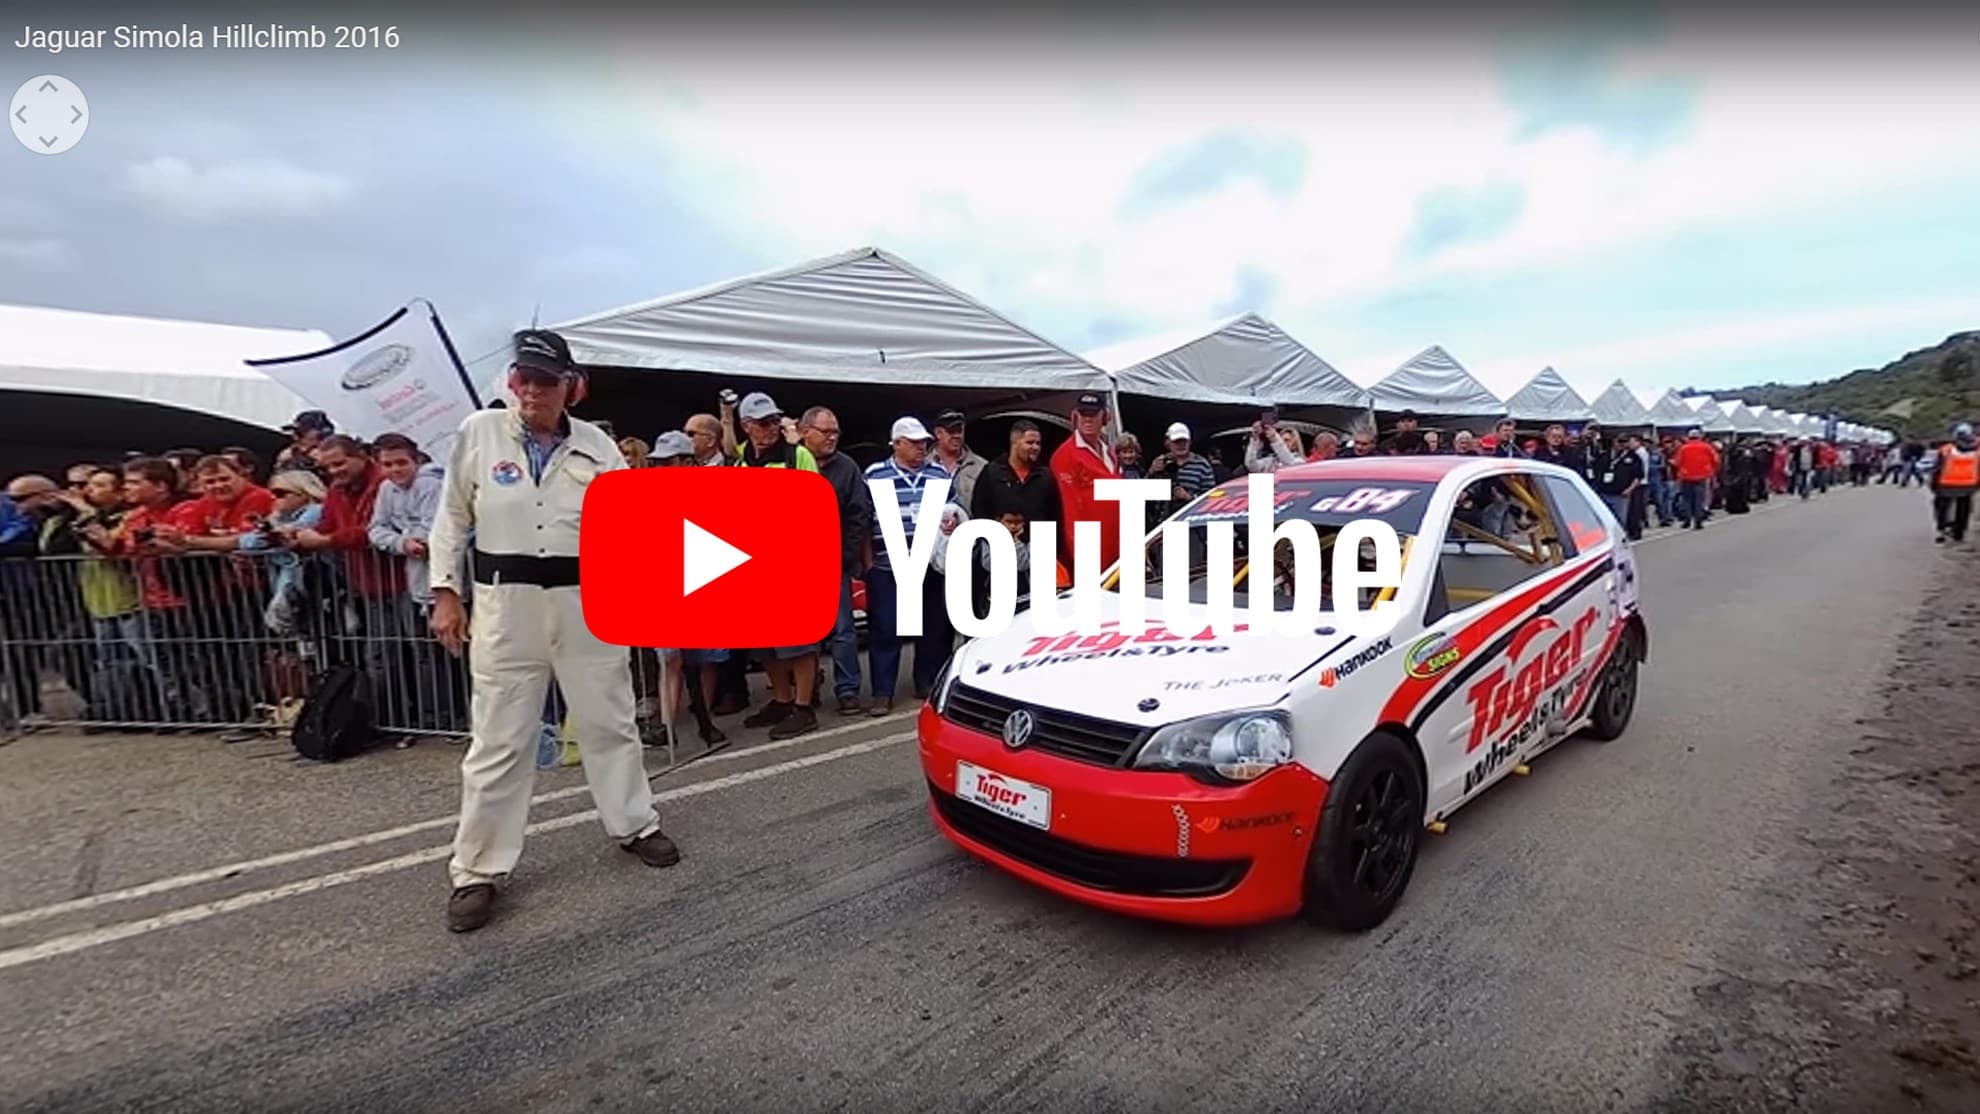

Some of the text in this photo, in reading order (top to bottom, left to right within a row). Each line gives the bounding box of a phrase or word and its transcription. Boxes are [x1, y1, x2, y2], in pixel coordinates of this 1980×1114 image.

[1164, 680, 1206, 692] THE
[1466, 605, 1600, 755] Tiger
[976, 773, 1028, 806] Tiger
